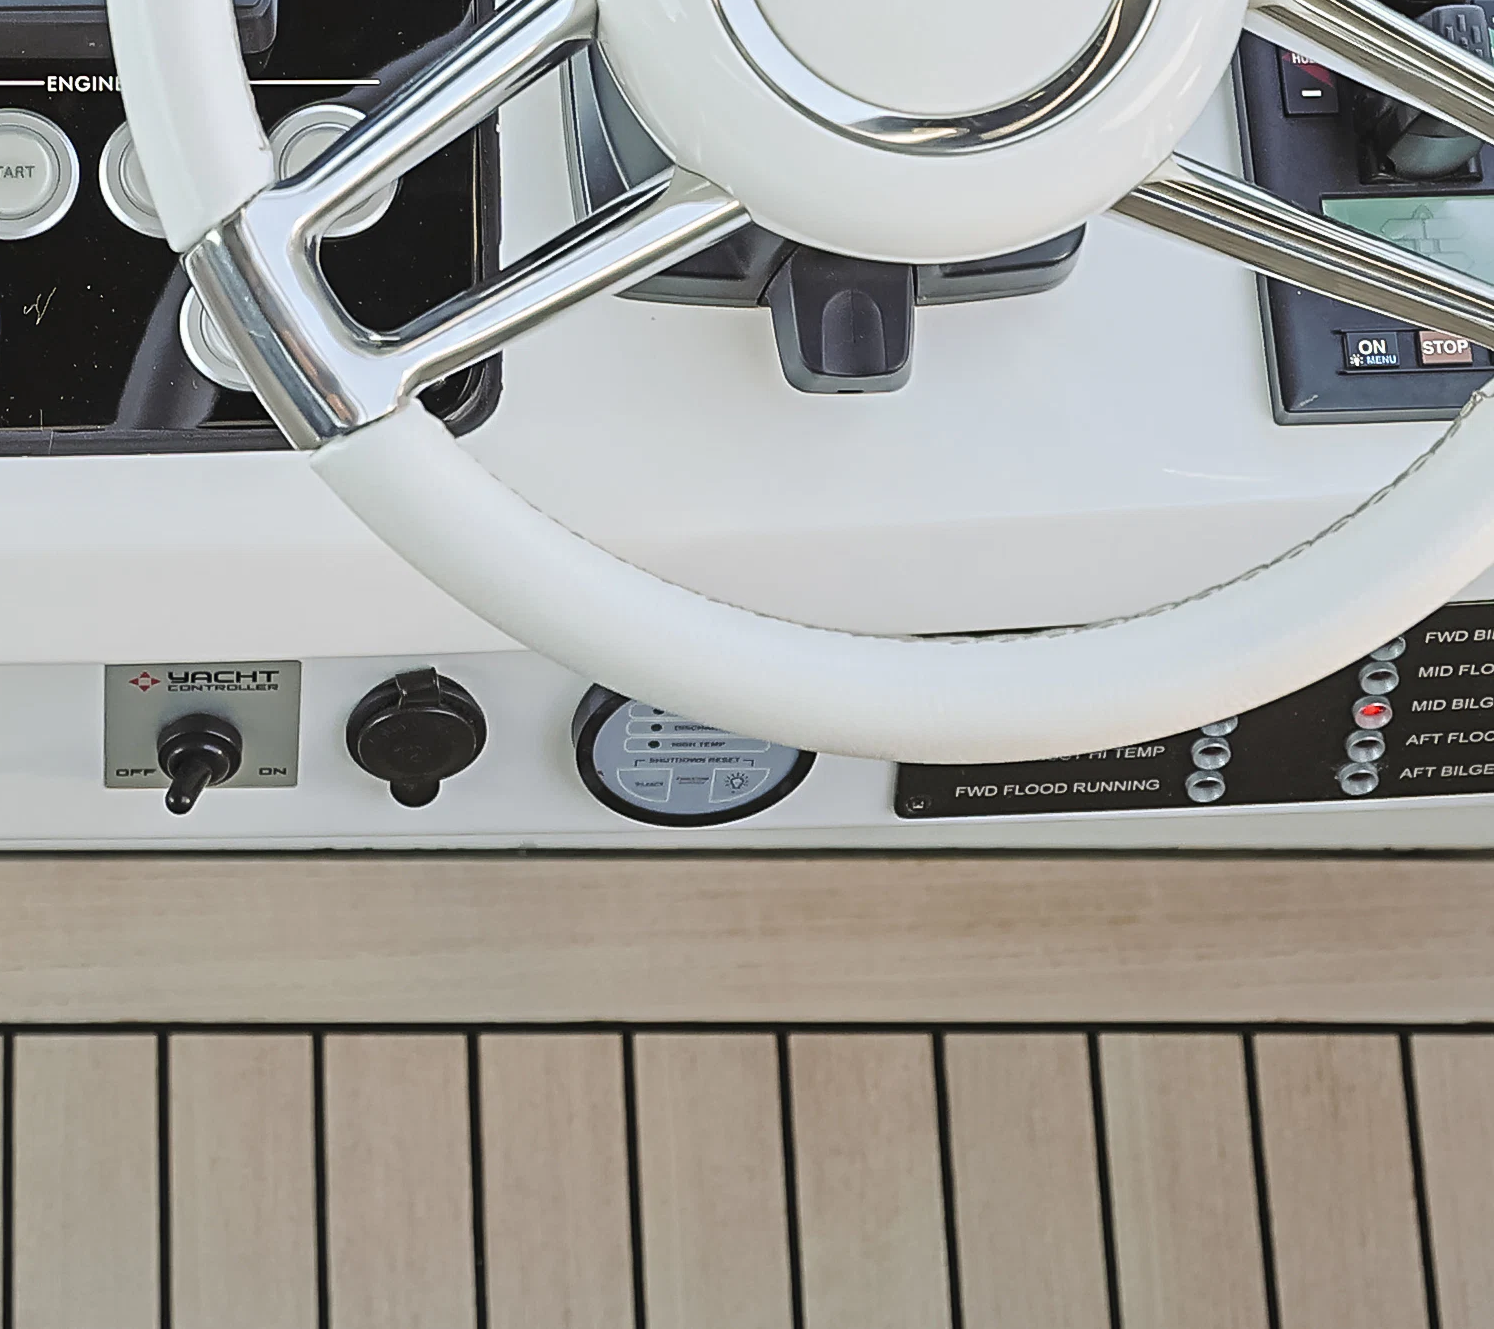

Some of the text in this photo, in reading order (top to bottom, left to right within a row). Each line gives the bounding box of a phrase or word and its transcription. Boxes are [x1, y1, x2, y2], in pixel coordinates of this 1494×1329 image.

[1359, 340, 1386, 354] ON
[1422, 339, 1469, 354] STOP
[1366, 355, 1397, 365] MENU
[1425, 630, 1468, 644] FWD
[168, 671, 279, 683] YACHT
[1418, 665, 1454, 678] MID
[168, 684, 278, 692] CONTROLLER
[1412, 699, 1446, 712] MID
[1406, 733, 1443, 746] AFT
[1113, 746, 1165, 760] TEMP
[116, 768, 157, 777] OFF
[259, 768, 287, 776] ON
[1400, 767, 1437, 780] AFT
[1440, 763, 1494, 777] BILGE
[956, 779, 1160, 797] FWD FLOOD RUNNING
